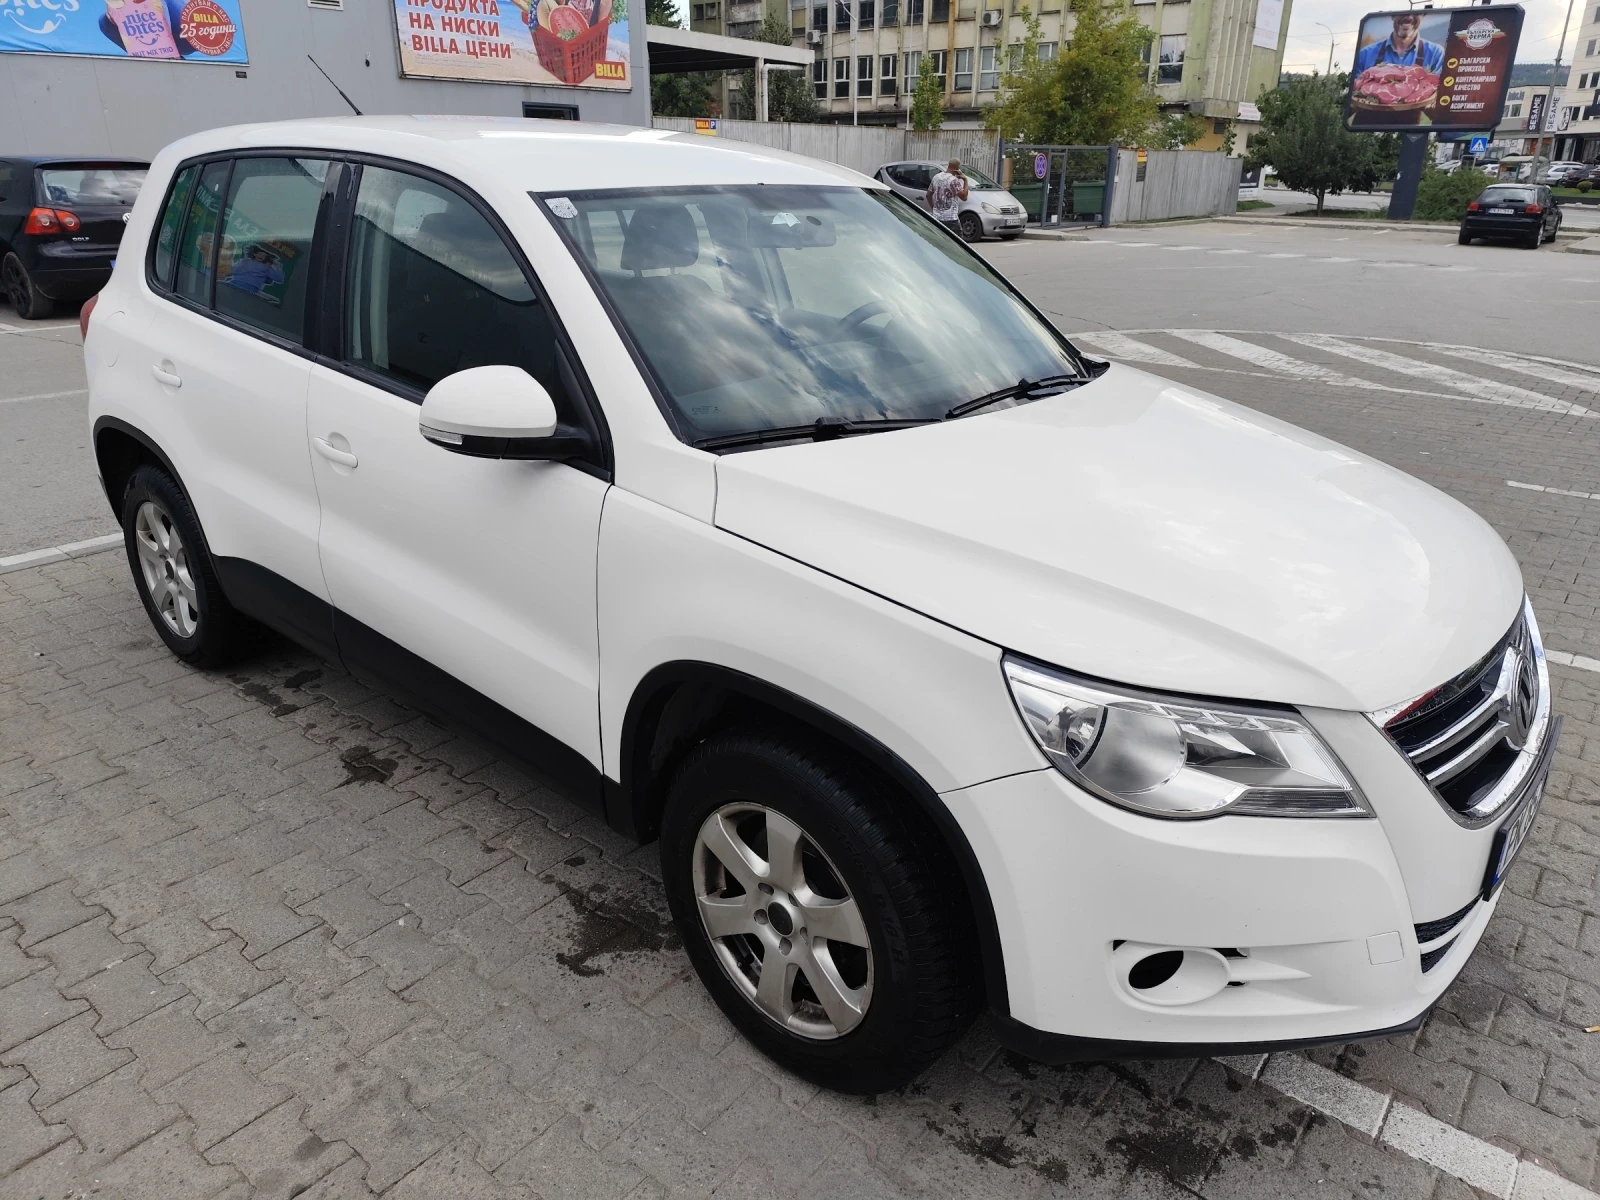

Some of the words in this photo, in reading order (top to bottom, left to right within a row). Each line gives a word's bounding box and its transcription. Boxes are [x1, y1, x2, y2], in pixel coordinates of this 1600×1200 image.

[125, 10, 158, 24] nice
[193, 13, 219, 24] BILLA
[409, 12, 434, 30] НА
[440, 16, 500, 37] НИСКИ
[122, 19, 165, 37] bites
[180, 22, 197, 38] 25
[198, 24, 237, 40] години
[411, 34, 460, 55] BILLA
[466, 39, 512, 59] ЦЕНИ
[595, 63, 625, 78] BILLA
[1529, 96, 1542, 131] SESAME
[1547, 96, 1560, 130] SESAME
